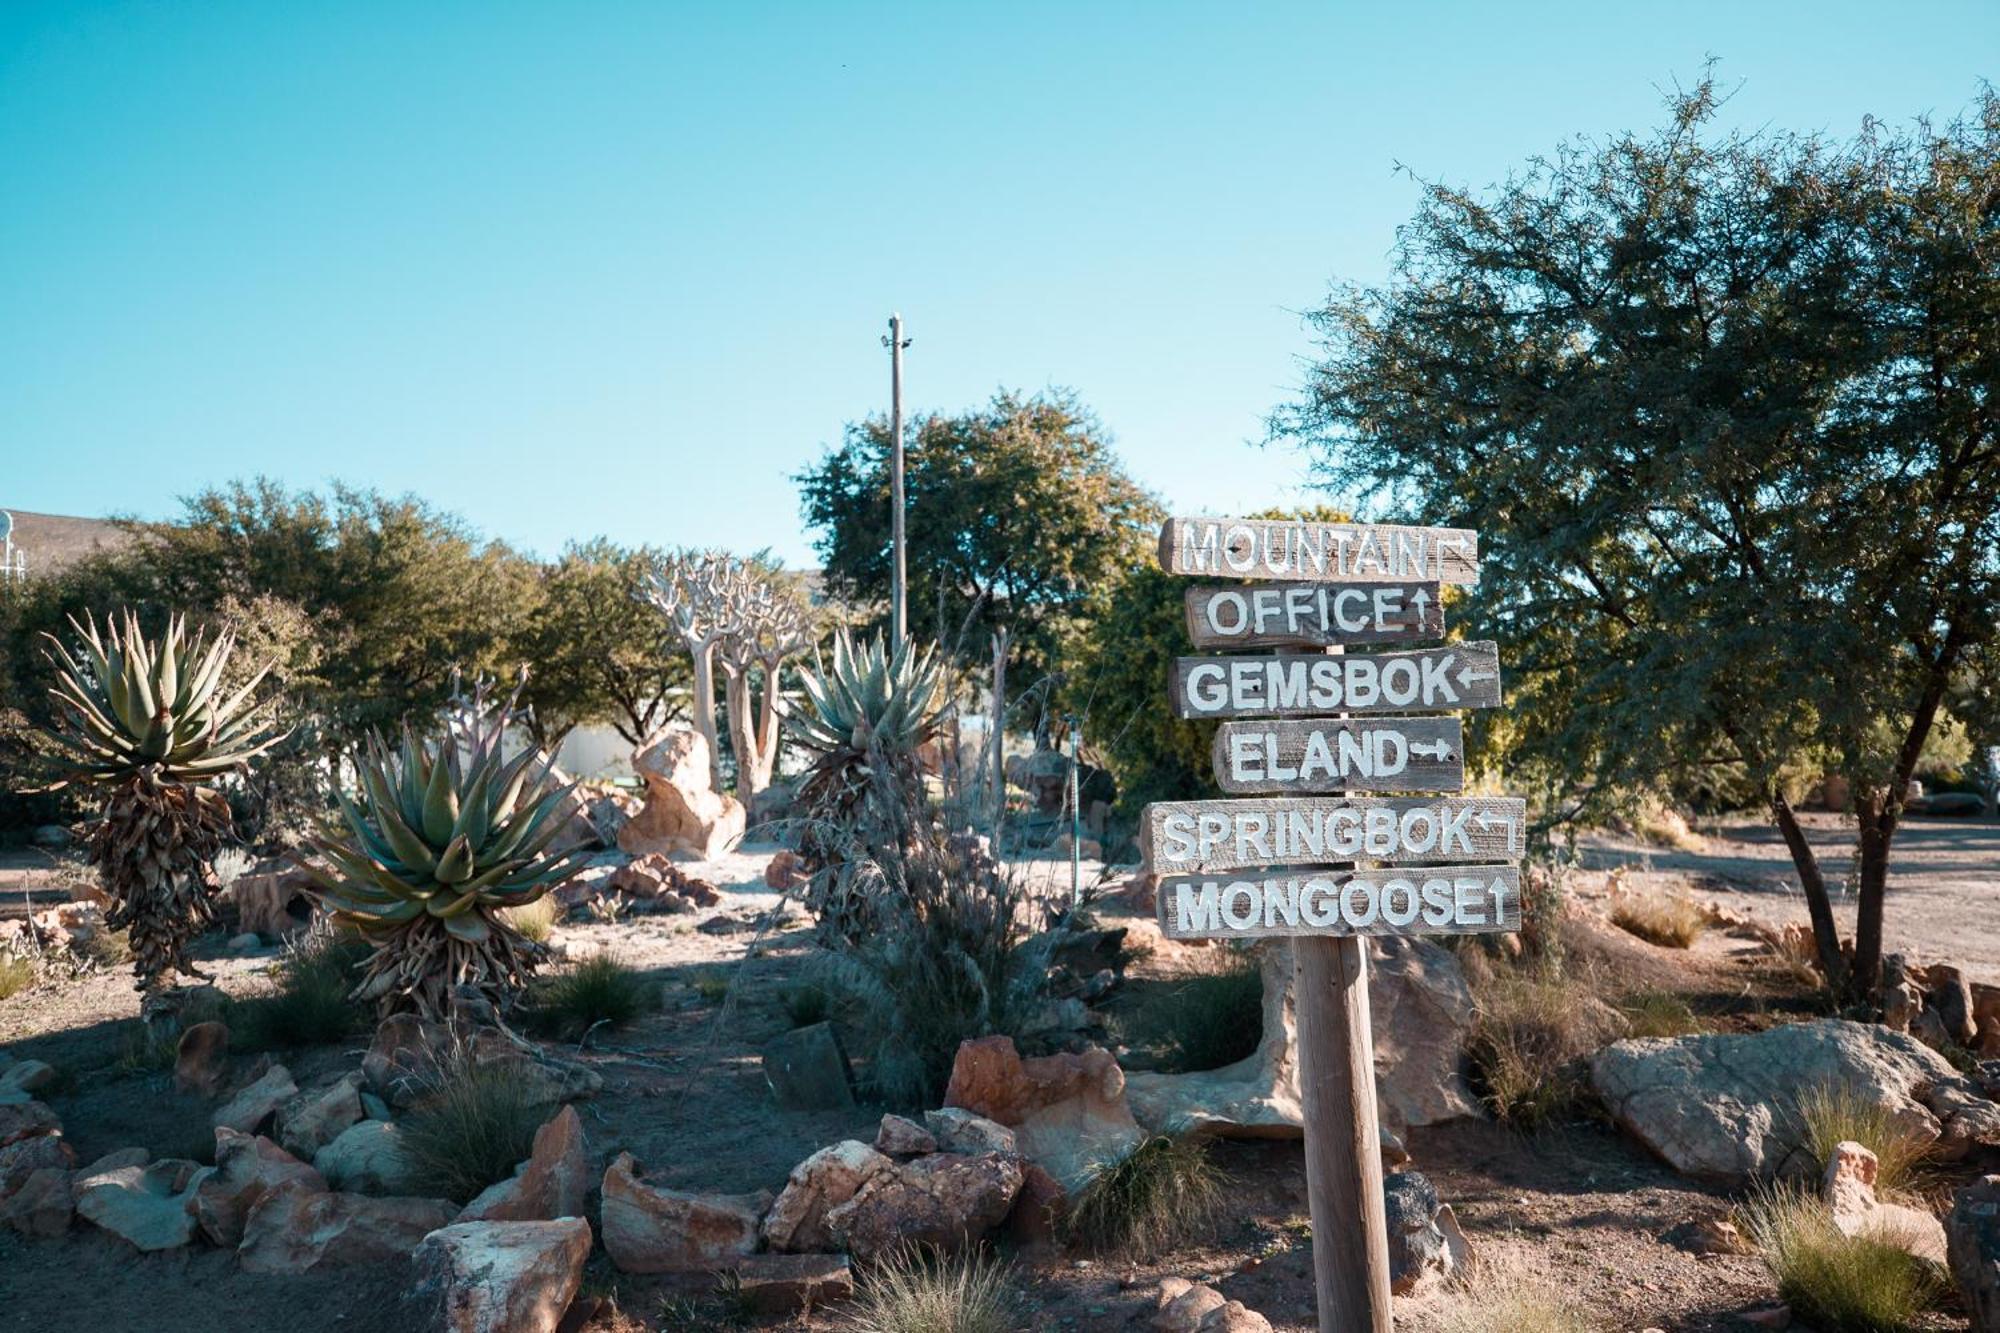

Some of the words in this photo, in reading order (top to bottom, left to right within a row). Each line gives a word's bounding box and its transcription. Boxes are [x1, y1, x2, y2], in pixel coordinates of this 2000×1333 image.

[1182, 523, 1429, 579] MOUNTAIN
[1207, 588, 1404, 635] OFFICE
[1186, 654, 1460, 711] GEMSBOK
[1230, 730, 1409, 781] ELAND
[1163, 806, 1475, 861] SPRINGBOK
[1176, 877, 1486, 931] MONGOOSE
